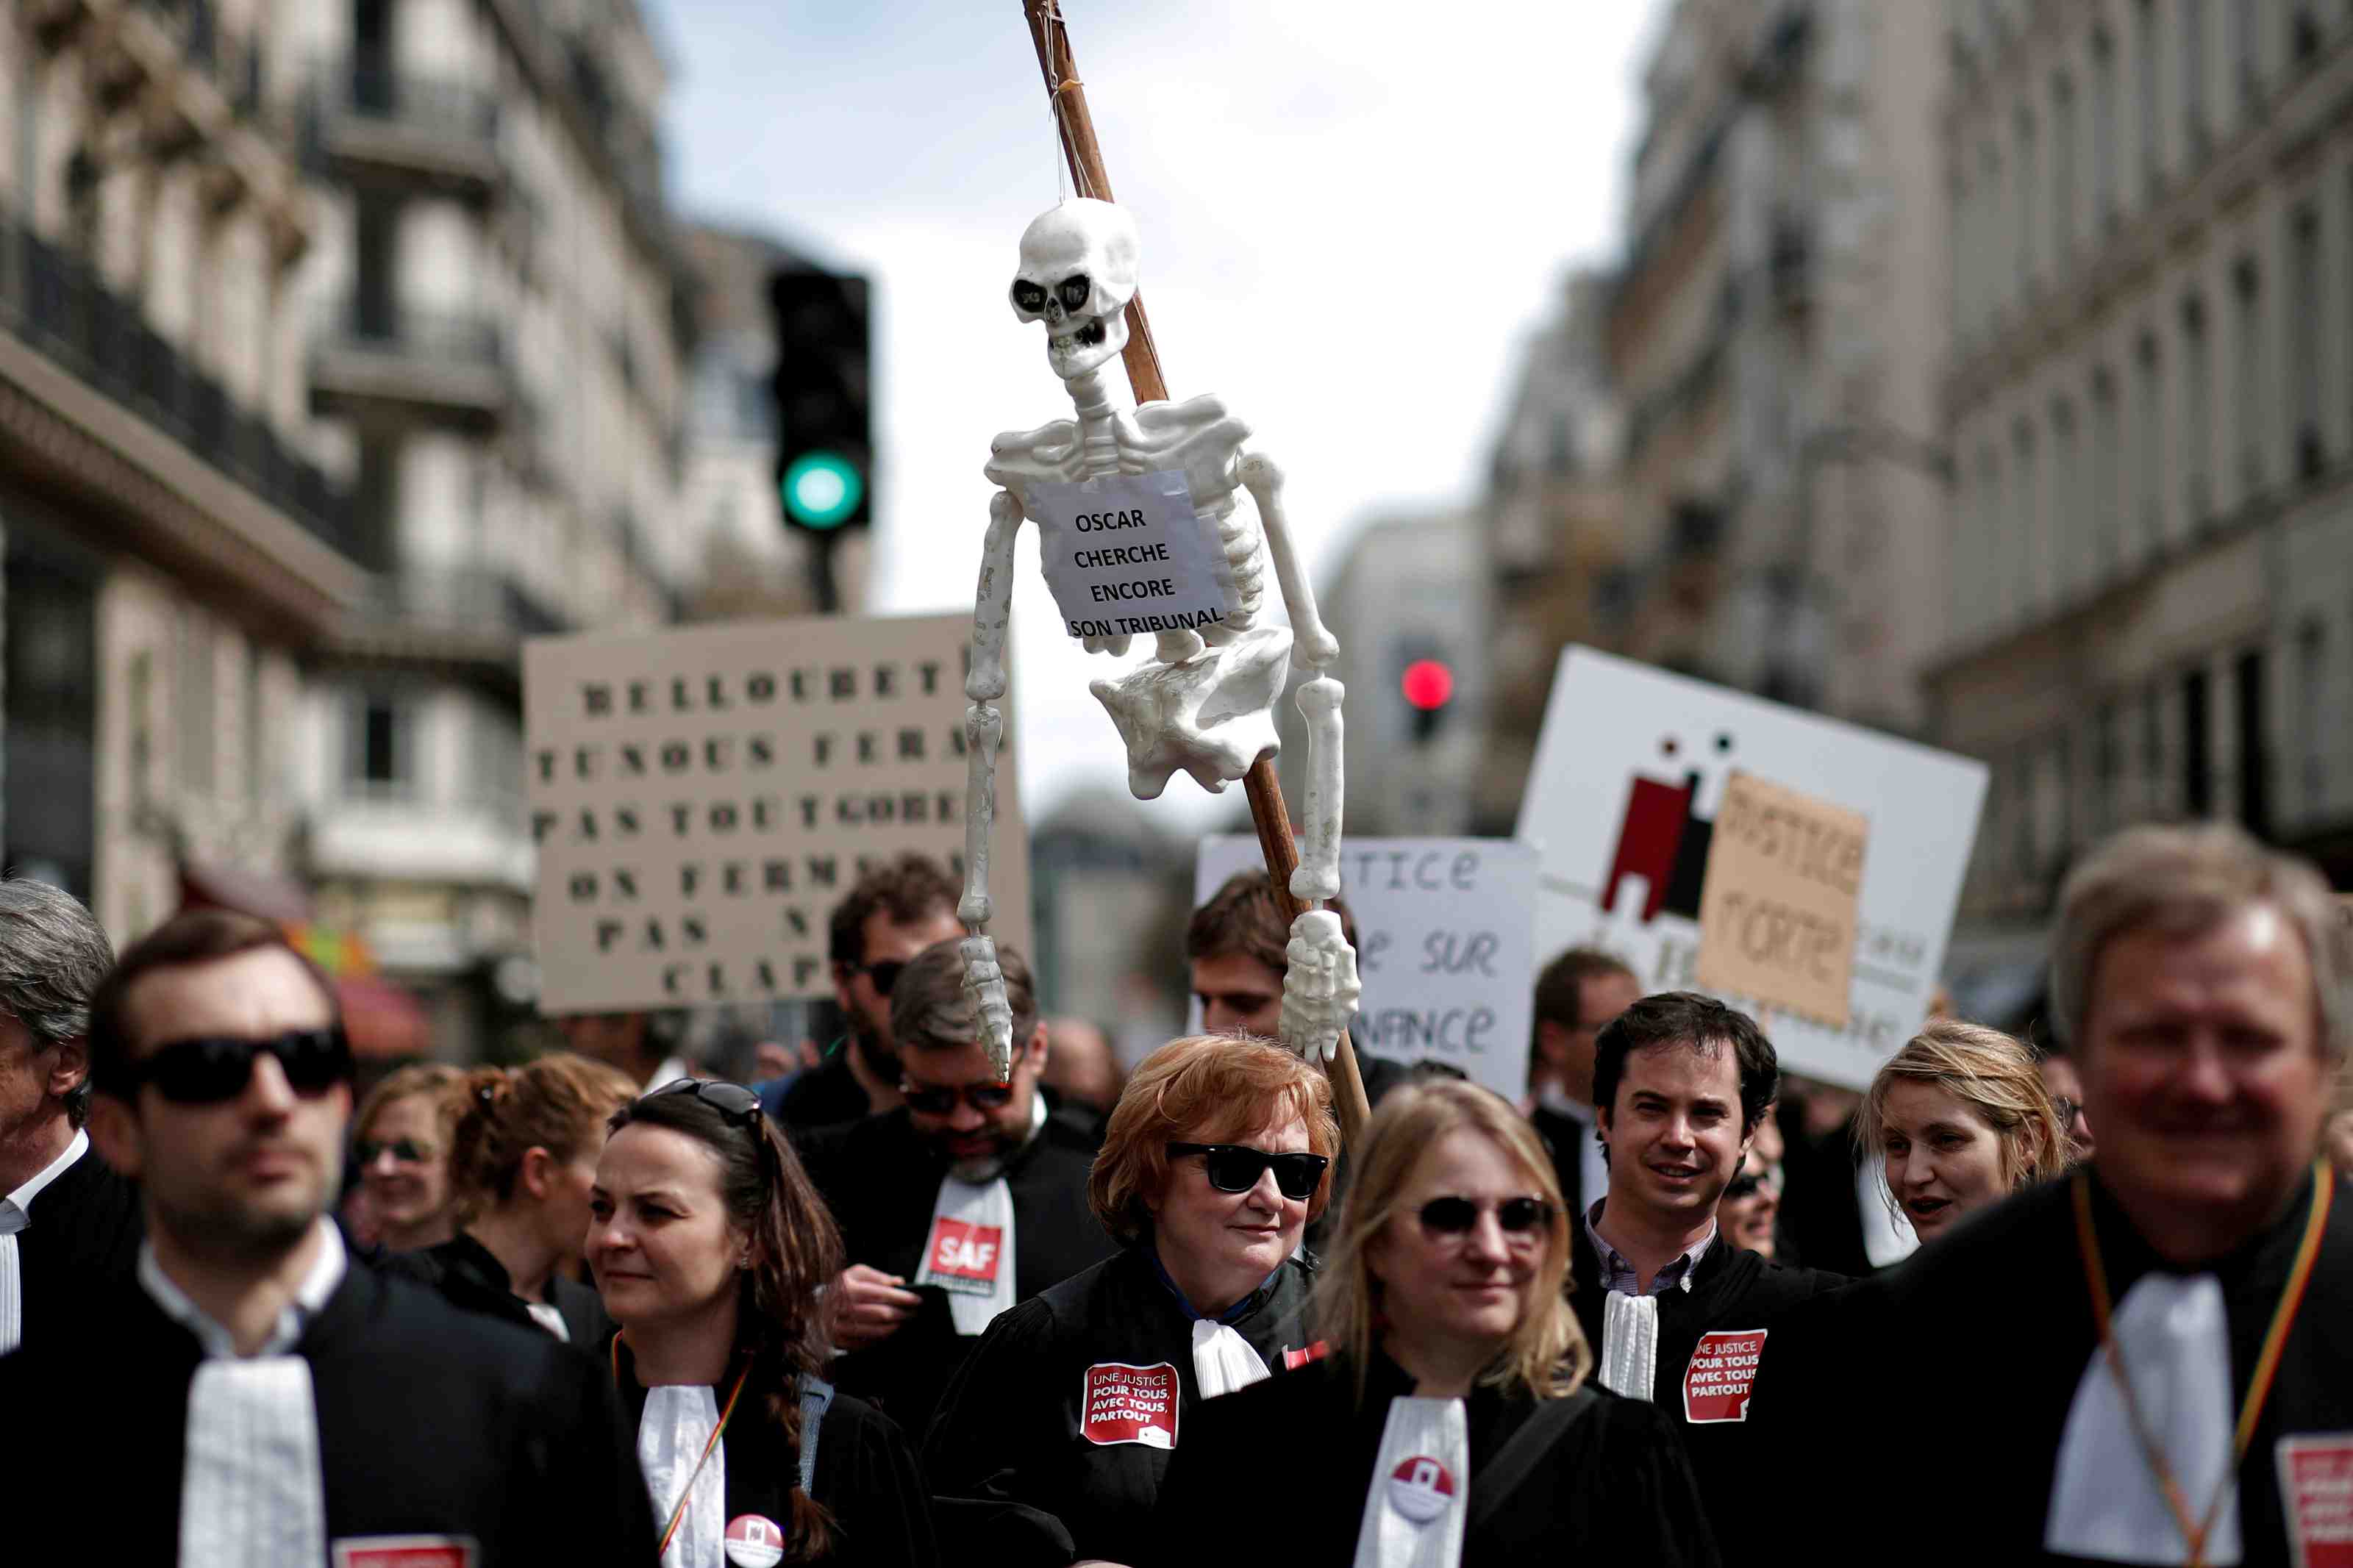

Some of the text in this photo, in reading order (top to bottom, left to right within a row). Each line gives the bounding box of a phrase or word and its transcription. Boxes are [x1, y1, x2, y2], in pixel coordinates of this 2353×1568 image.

[1076, 509, 1146, 532] OSCAR
[1074, 543, 1170, 568] CHERCHE
[1090, 579, 1175, 602] ENCORE
[1070, 607, 1224, 637] SON TRIBUNAL
[815, 726, 1005, 766] FERA
[838, 791, 996, 823] GOBE
[938, 1236, 996, 1270] SAF
[1696, 1340, 1757, 1355] NE JUSTICE
[1691, 1357, 1723, 1369] POUR
[1093, 1372, 1168, 1386] UNE JUSTICE
[1690, 1372, 1722, 1383] AVEC
[1093, 1385, 1170, 1400] POUR TOUS,
[1691, 1383, 1749, 1397] PARTOUT
[1091, 1397, 1168, 1414] AVEC TOUS,
[1090, 1409, 1151, 1424] PARTOUT
